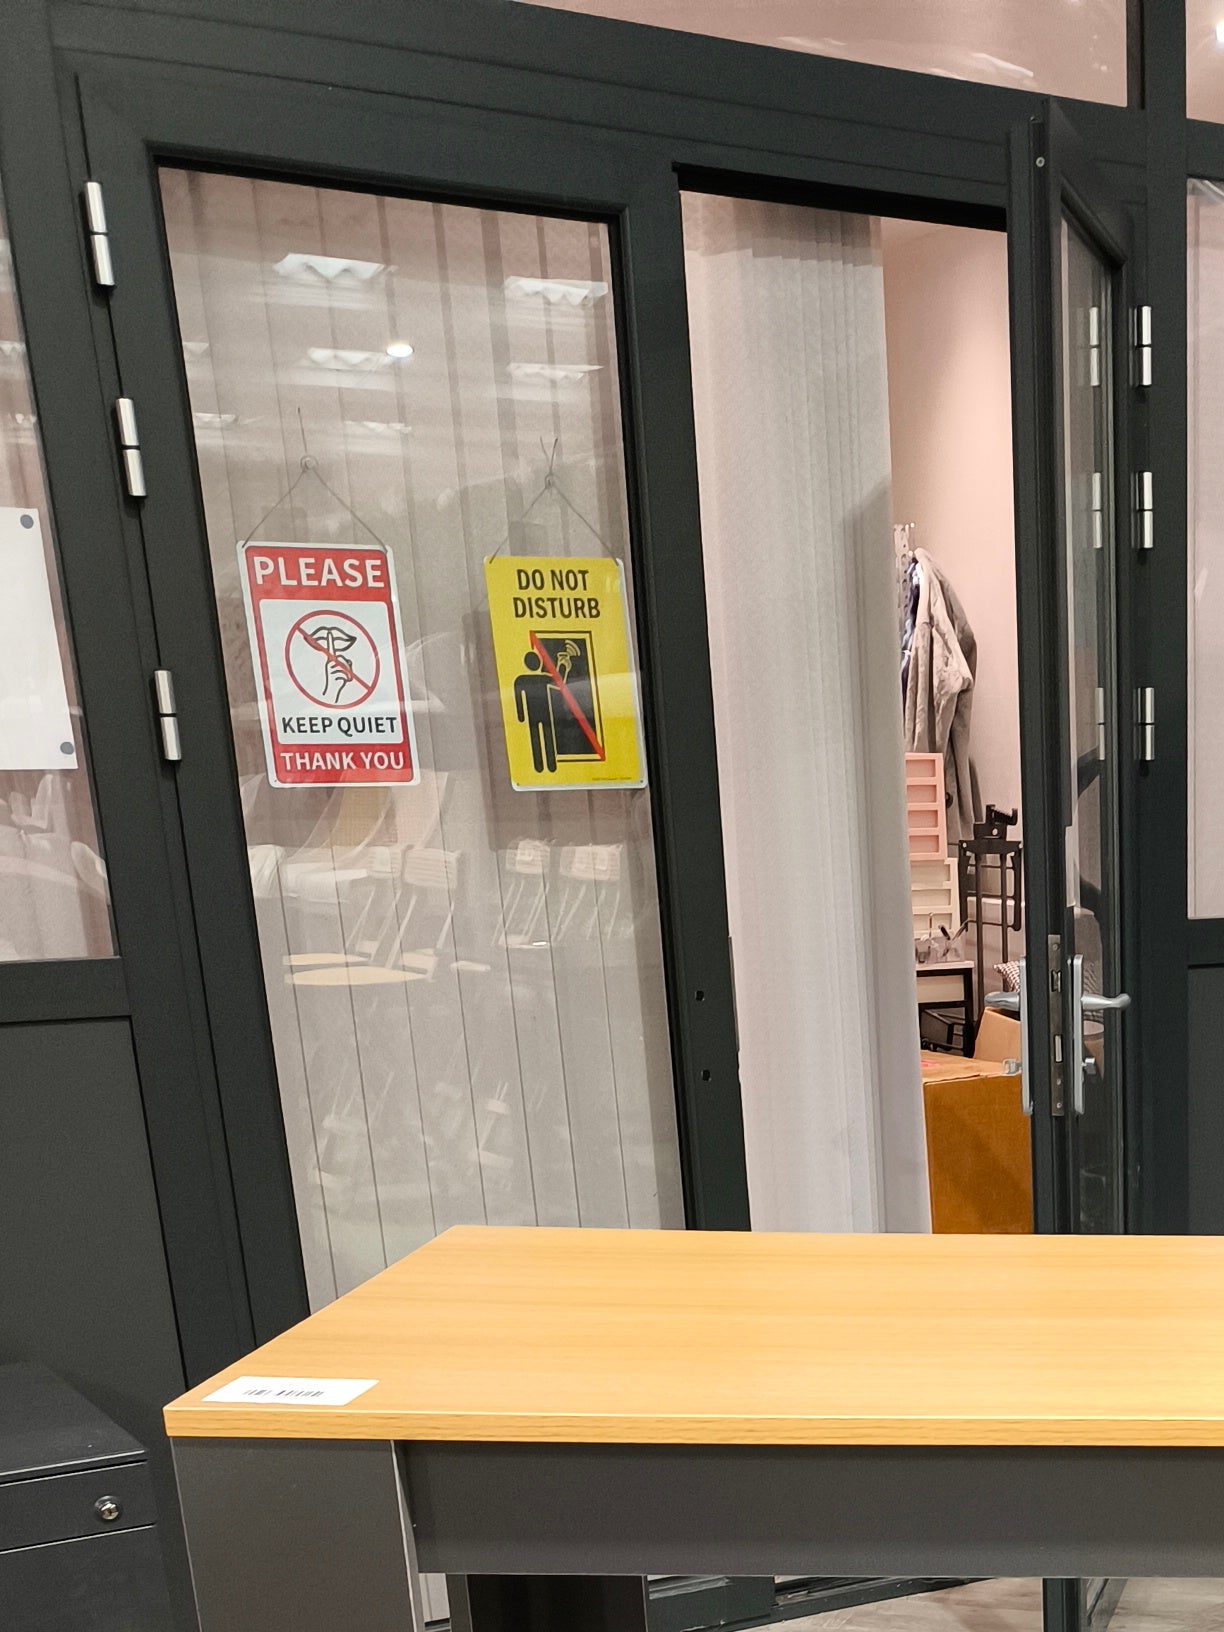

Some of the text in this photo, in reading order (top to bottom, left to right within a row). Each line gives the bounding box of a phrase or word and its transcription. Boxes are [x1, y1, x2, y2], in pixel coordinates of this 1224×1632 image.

[253, 556, 385, 588] PLEASE
[516, 568, 589, 592] DO NOT
[512, 596, 601, 619] DISTURB
[281, 716, 398, 738] KEEP QUIET
[280, 751, 404, 771] THANK YOU
